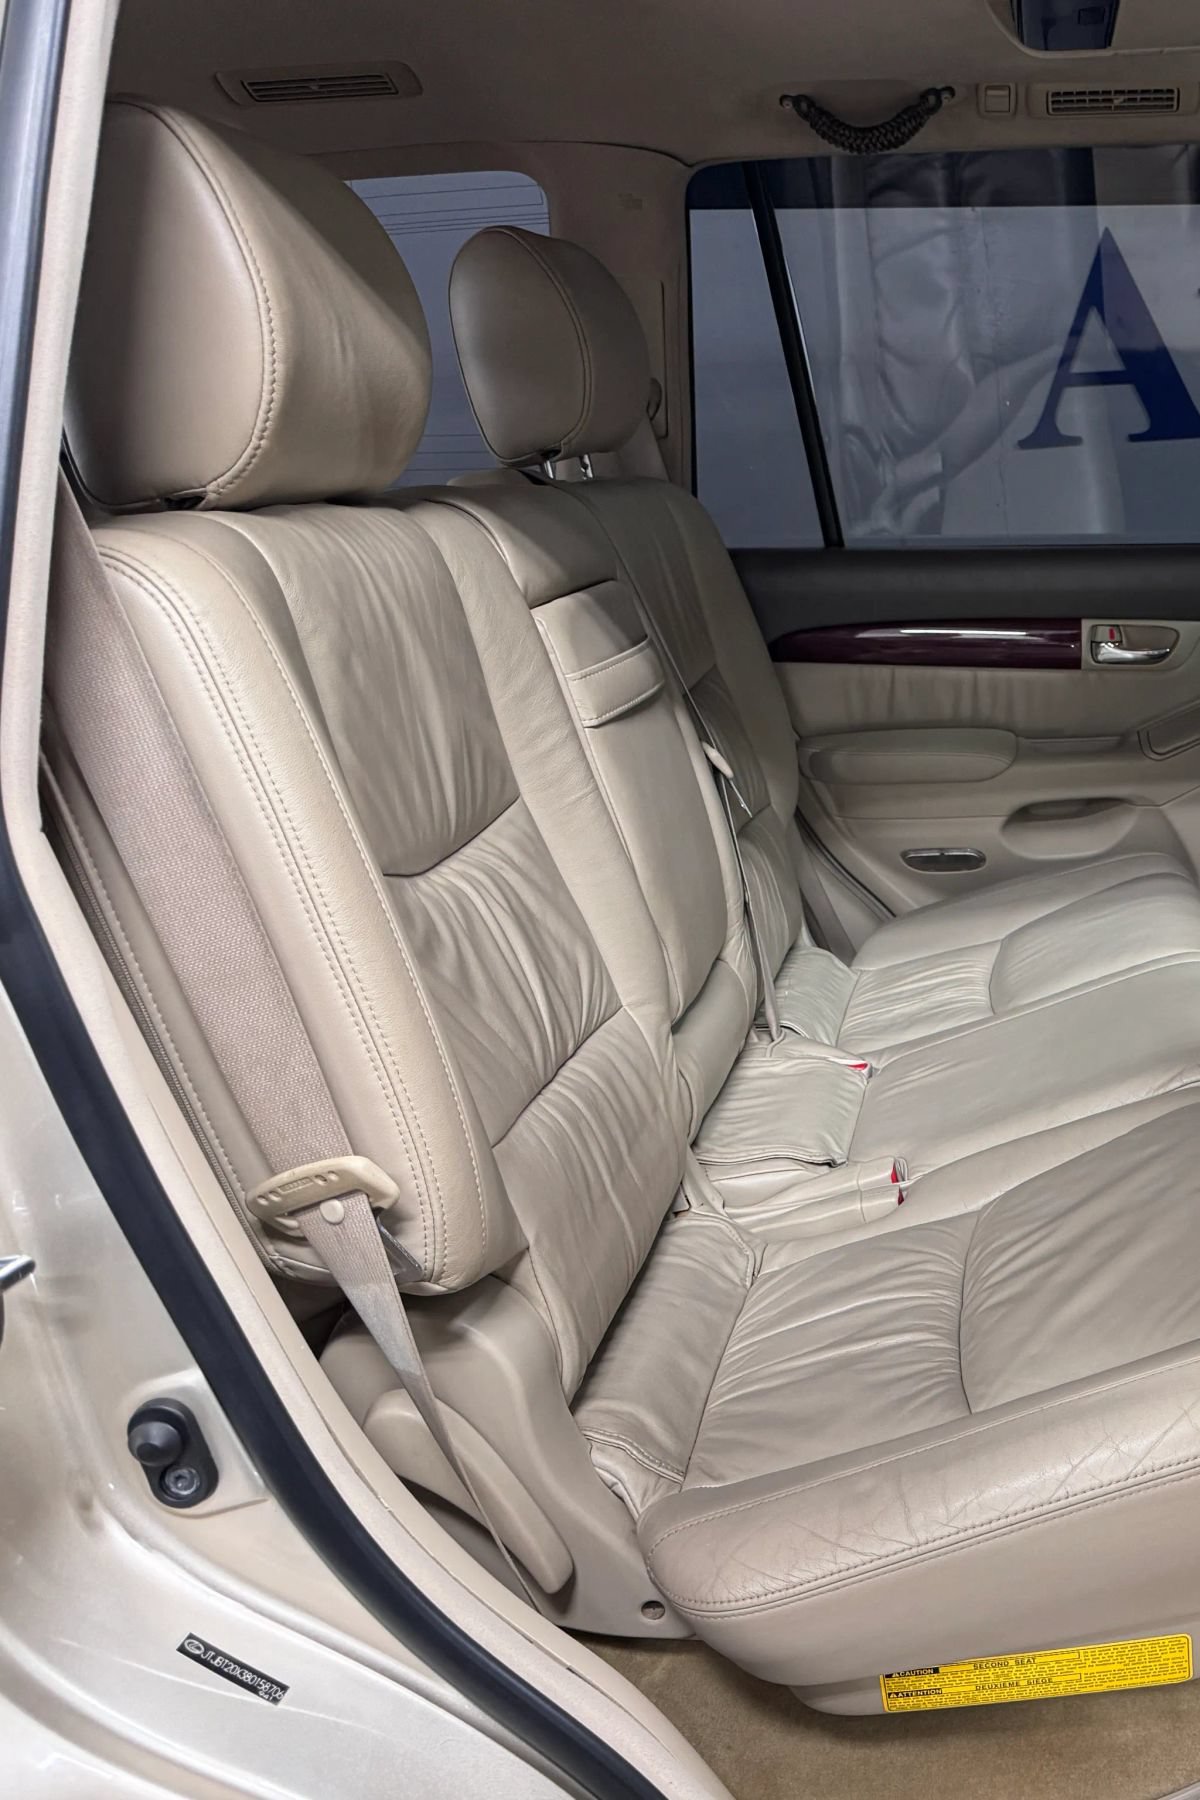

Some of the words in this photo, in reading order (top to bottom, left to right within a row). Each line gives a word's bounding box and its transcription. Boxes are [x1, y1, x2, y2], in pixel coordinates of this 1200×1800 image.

[973, 1660, 1009, 1670] SECOND
[1014, 1657, 1036, 1666] SEAT
[900, 1668, 934, 1677] CAUTION
[898, 1689, 942, 1698] ATTENTION
